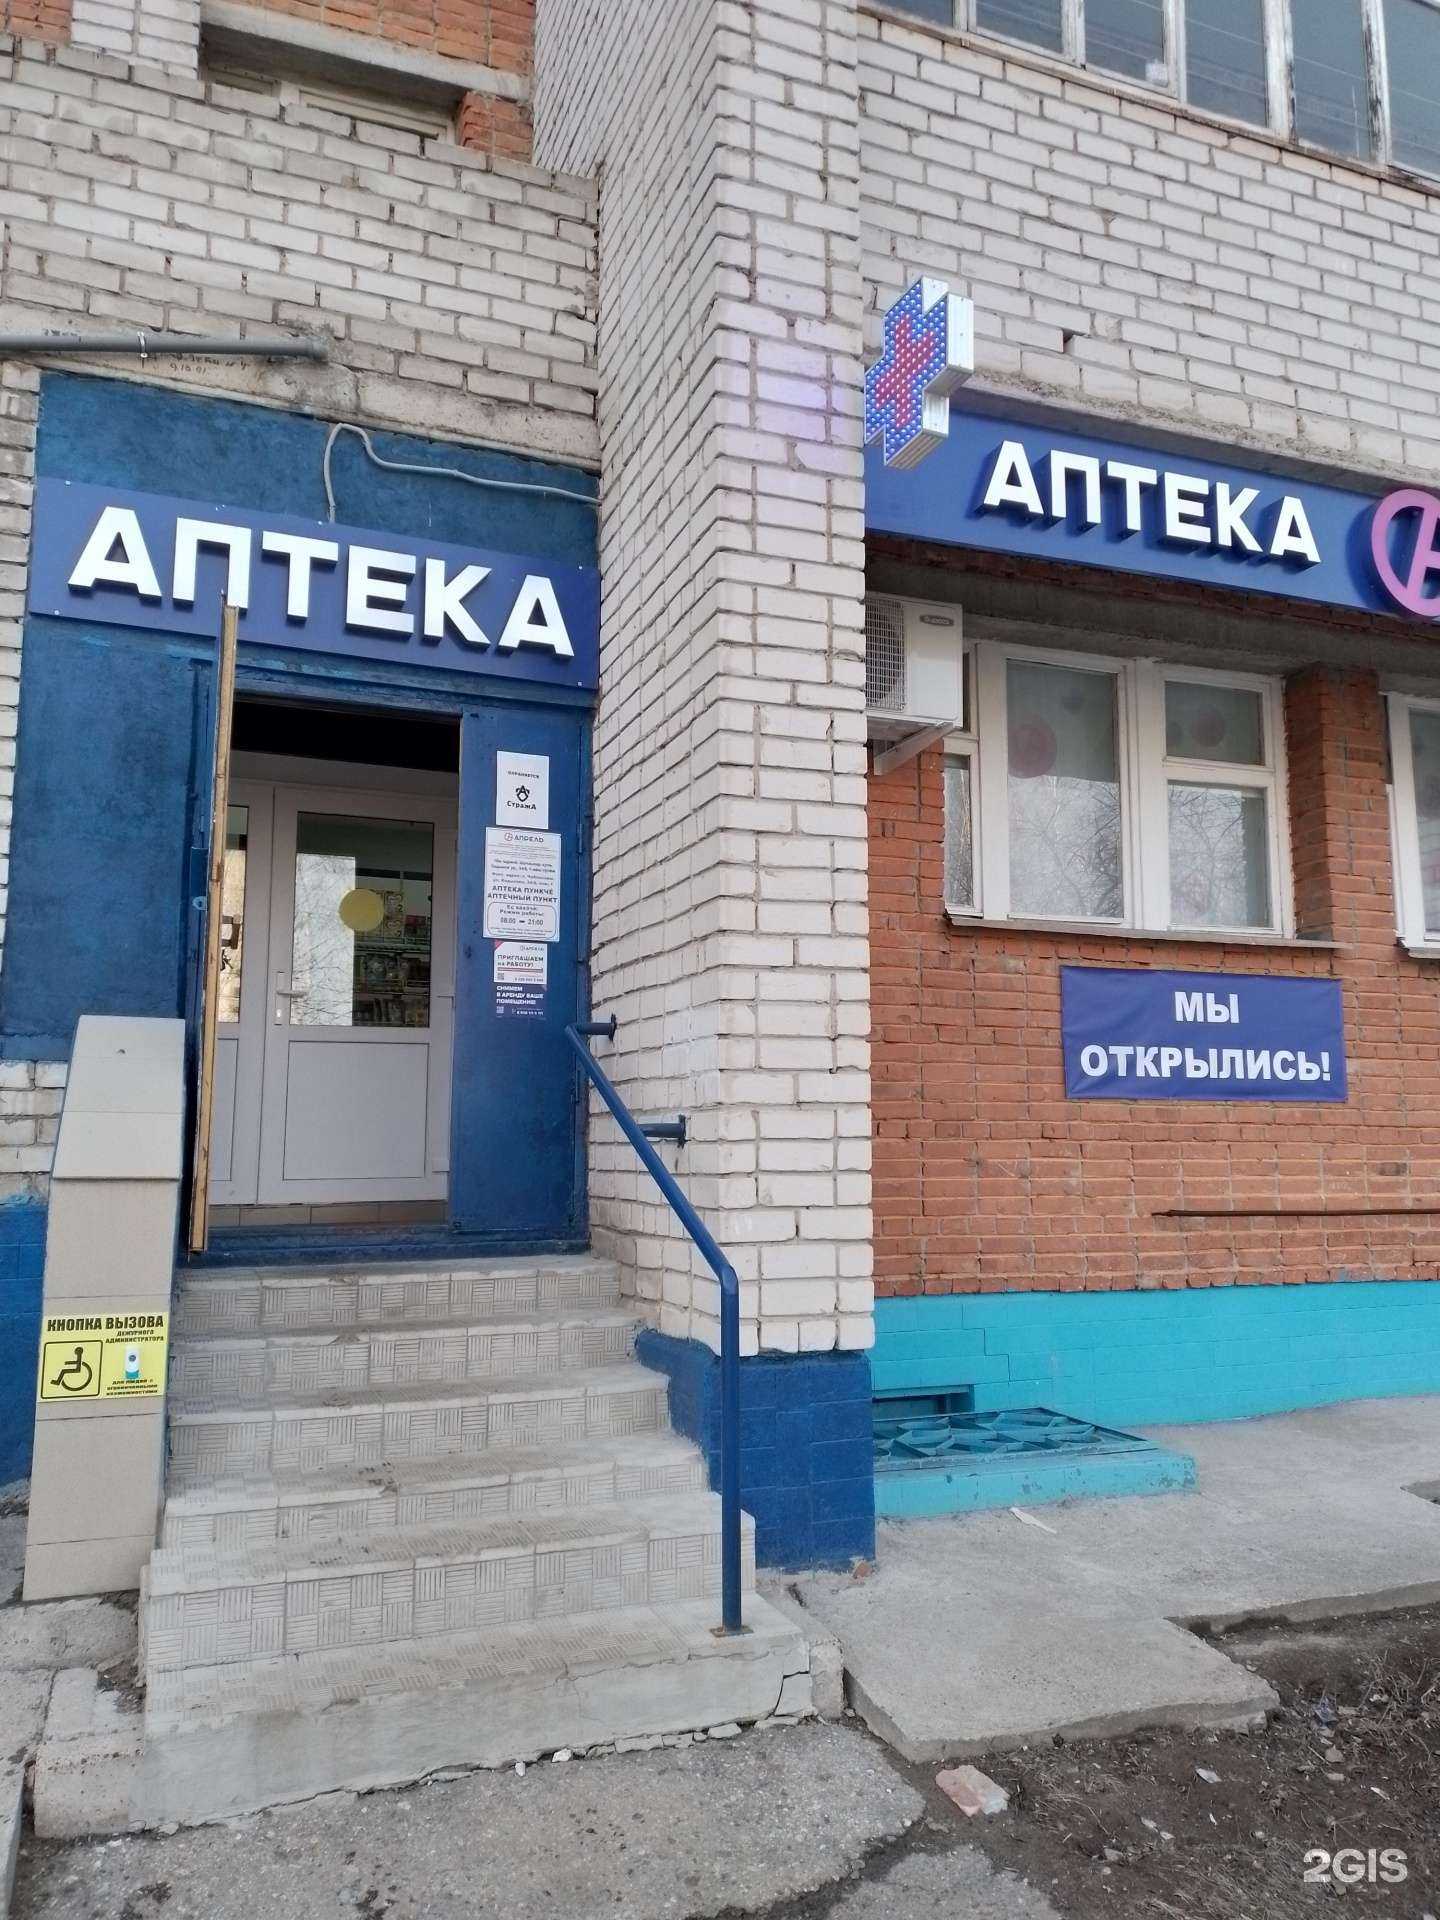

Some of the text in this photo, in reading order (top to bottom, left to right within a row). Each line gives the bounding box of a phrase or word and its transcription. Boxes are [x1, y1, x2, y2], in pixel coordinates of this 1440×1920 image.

[982, 439, 1321, 563] АПТЕКА
[67, 506, 575, 658] АПТЕКА
[492, 885, 522, 893] АПТЕКА
[1174, 991, 1240, 1024] МЫ
[1080, 1044, 1331, 1081] ОТКРЫЛИСЬ!
[47, 1315, 164, 1331] КНОПКА ВЫЗОВА
